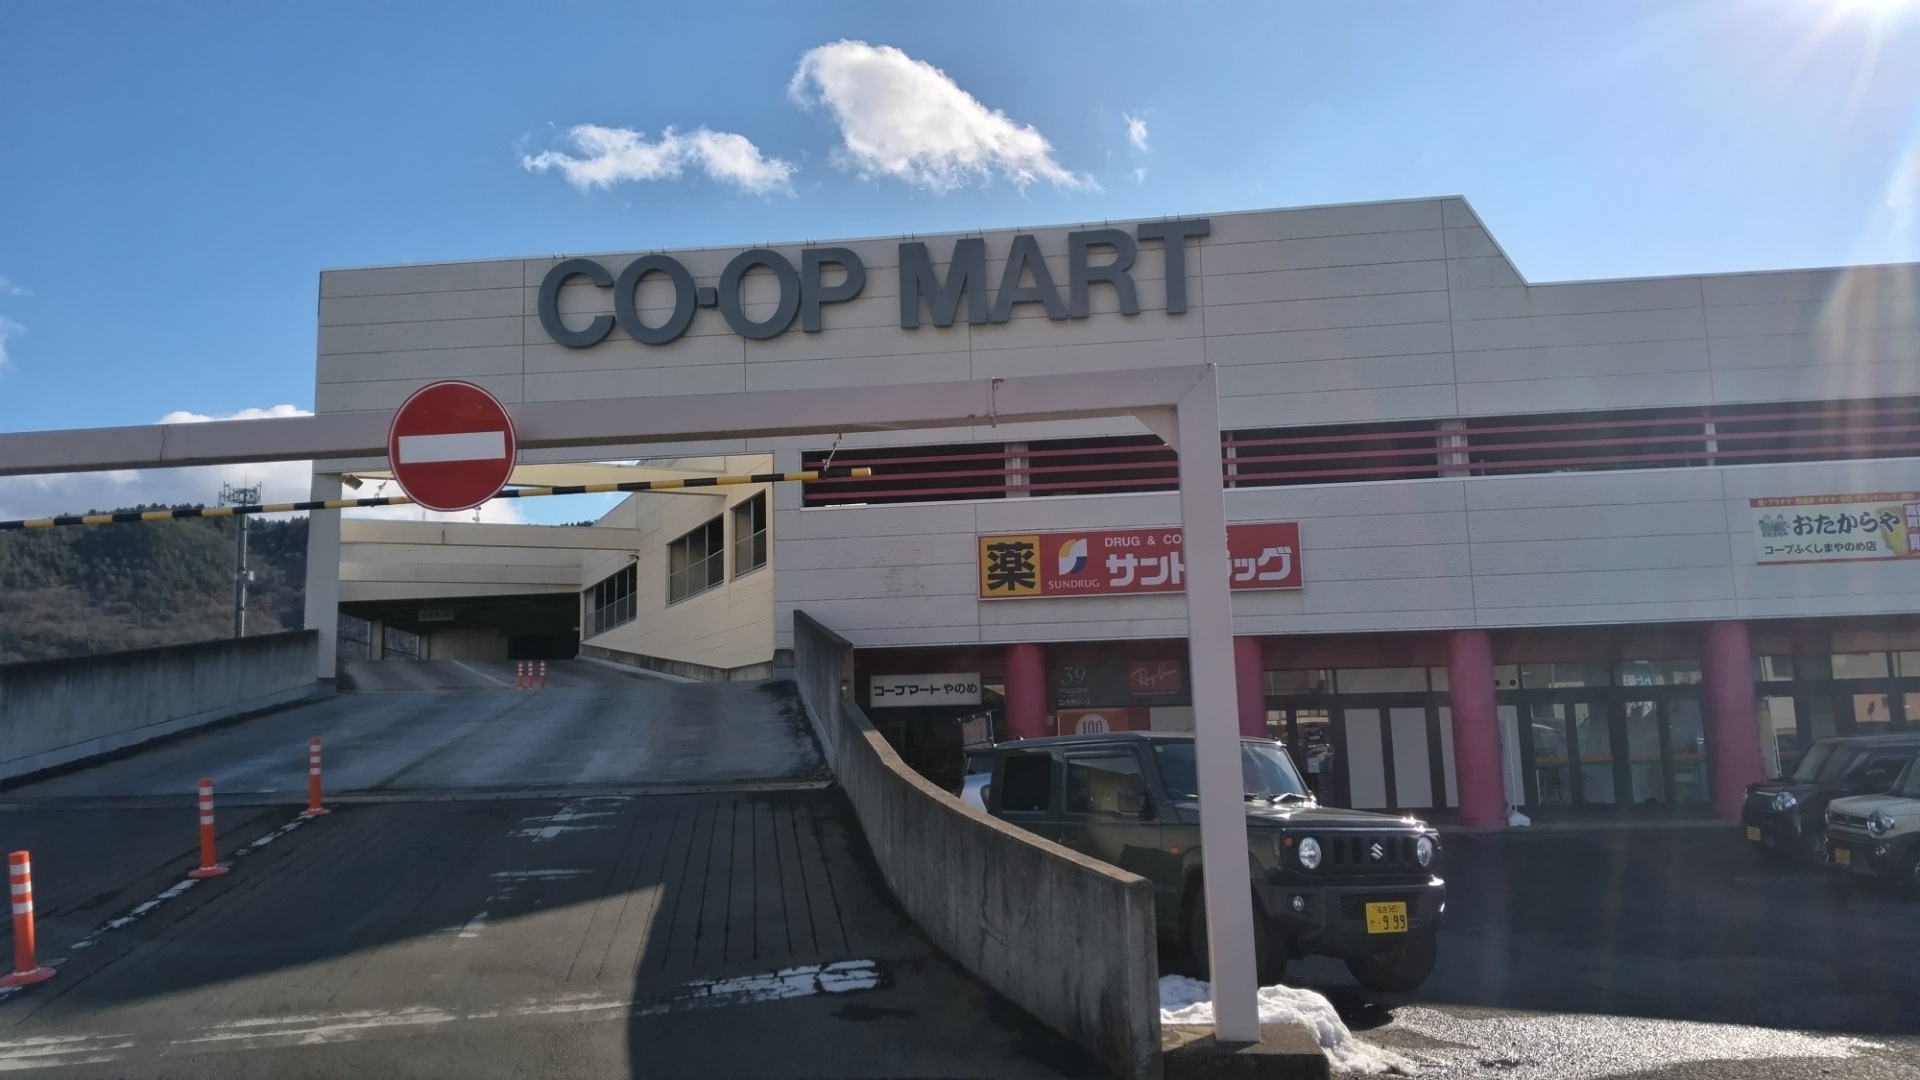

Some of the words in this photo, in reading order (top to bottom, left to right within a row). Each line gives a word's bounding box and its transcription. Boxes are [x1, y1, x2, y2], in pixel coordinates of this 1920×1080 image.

[537, 245, 866, 349] CO-OP
[899, 219, 1211, 330] MART
[1793, 512, 1901, 536] おたからや
[1104, 536, 1140, 548] DRUG
[1147, 535, 1156, 546] &
[1764, 541, 1877, 555] コープふくしまやのめ店
[986, 541, 1036, 591] 薬
[1048, 578, 1100, 590] SUNDRUG
[1061, 665, 1086, 686] 39
[1131, 662, 1177, 687] Ray-Ban
